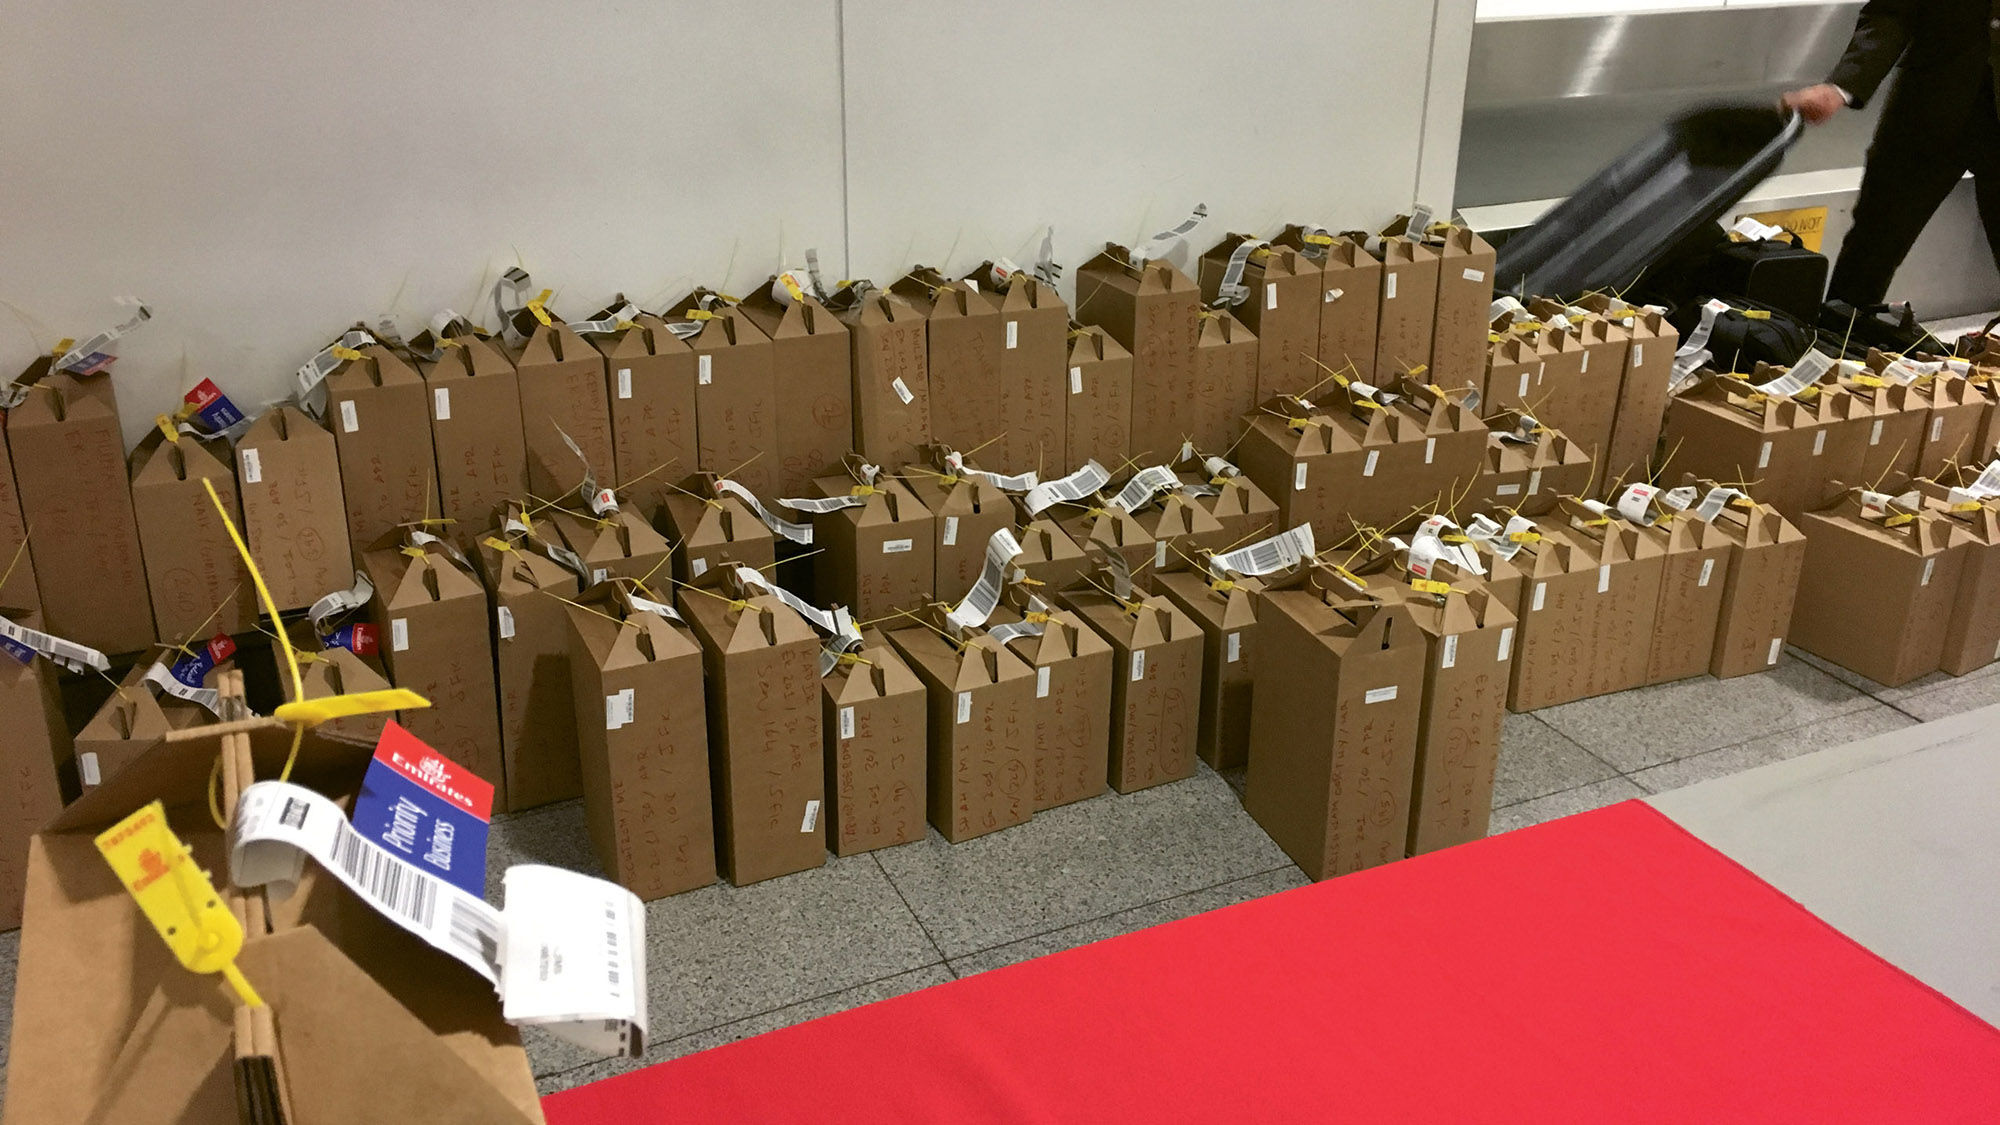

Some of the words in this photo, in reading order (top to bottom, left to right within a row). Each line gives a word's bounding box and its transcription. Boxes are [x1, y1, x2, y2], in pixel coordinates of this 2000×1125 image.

[1799, 215, 1823, 231] NOT
[391, 750, 475, 809] Emirates
[381, 795, 430, 855] Priority
[423, 817, 456, 872] Business
